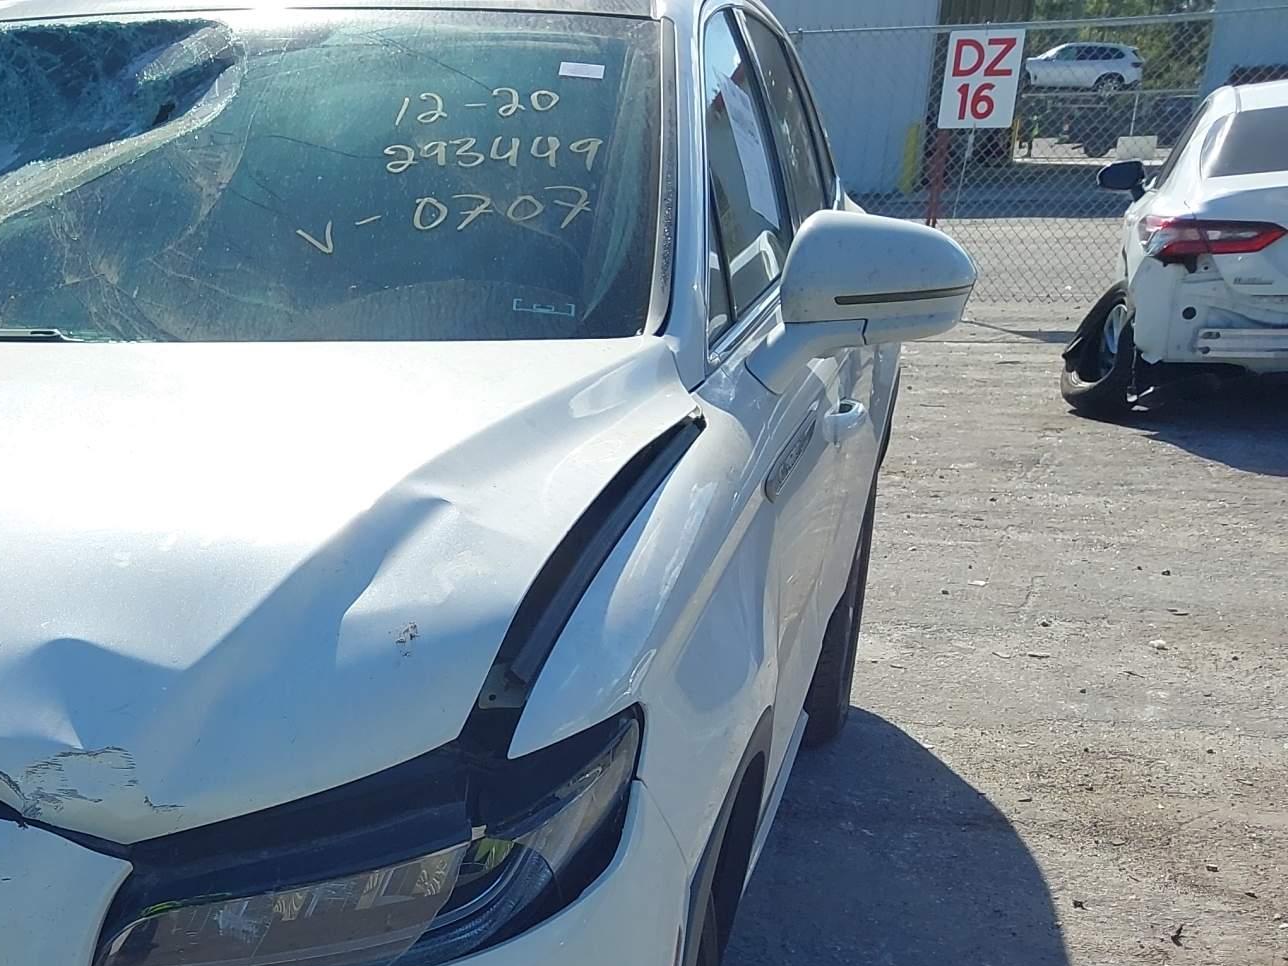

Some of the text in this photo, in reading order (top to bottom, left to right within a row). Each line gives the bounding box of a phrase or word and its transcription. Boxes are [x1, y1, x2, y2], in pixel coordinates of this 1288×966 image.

[952, 38, 1017, 77] DZ
[957, 83, 996, 120] 16
[383, 136, 604, 173] 293449
